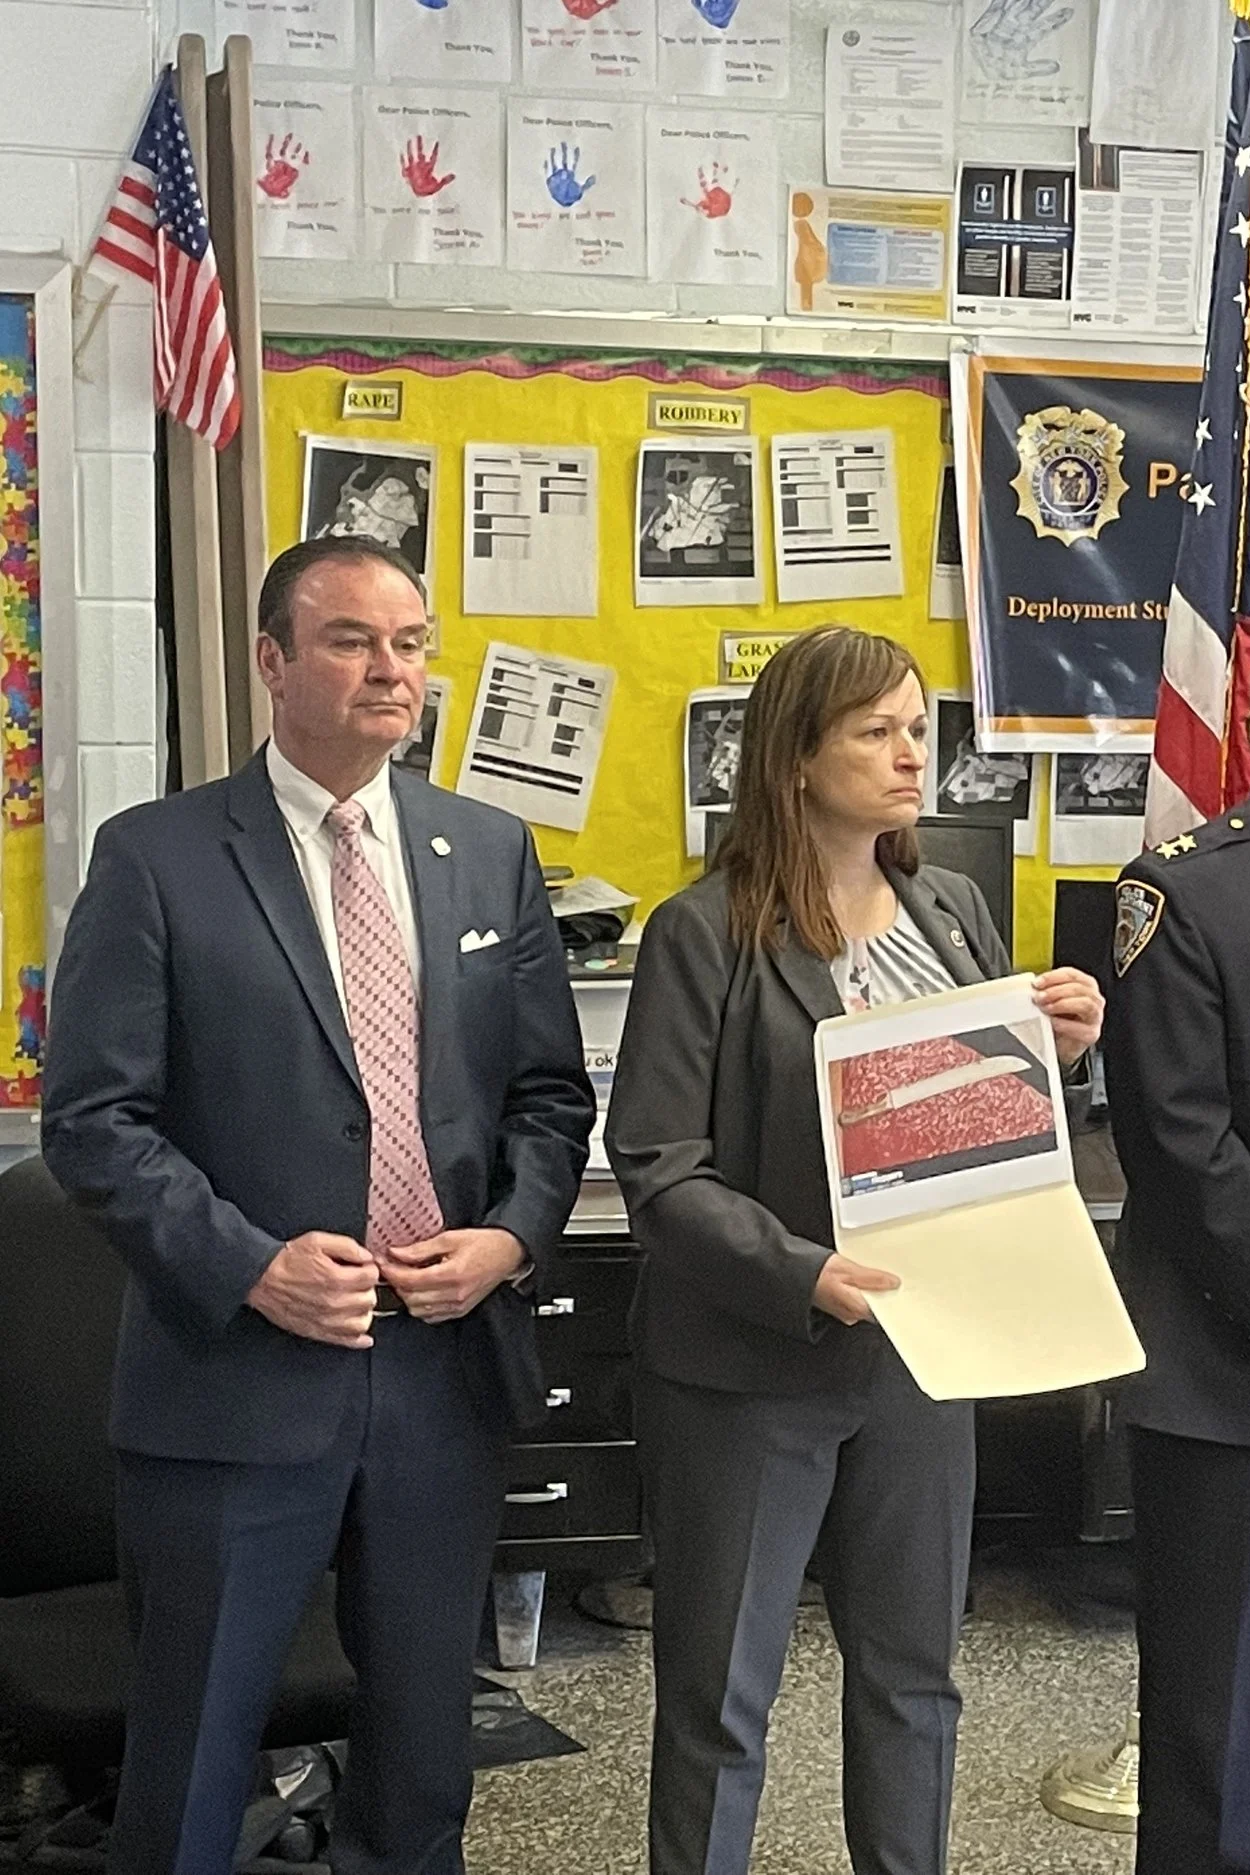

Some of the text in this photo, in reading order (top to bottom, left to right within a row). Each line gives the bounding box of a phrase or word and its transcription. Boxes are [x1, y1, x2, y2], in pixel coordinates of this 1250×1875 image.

[348, 392, 395, 409] RAPE
[660, 405, 741, 424] ROBBERY
[1008, 596, 1138, 624] Deployment
